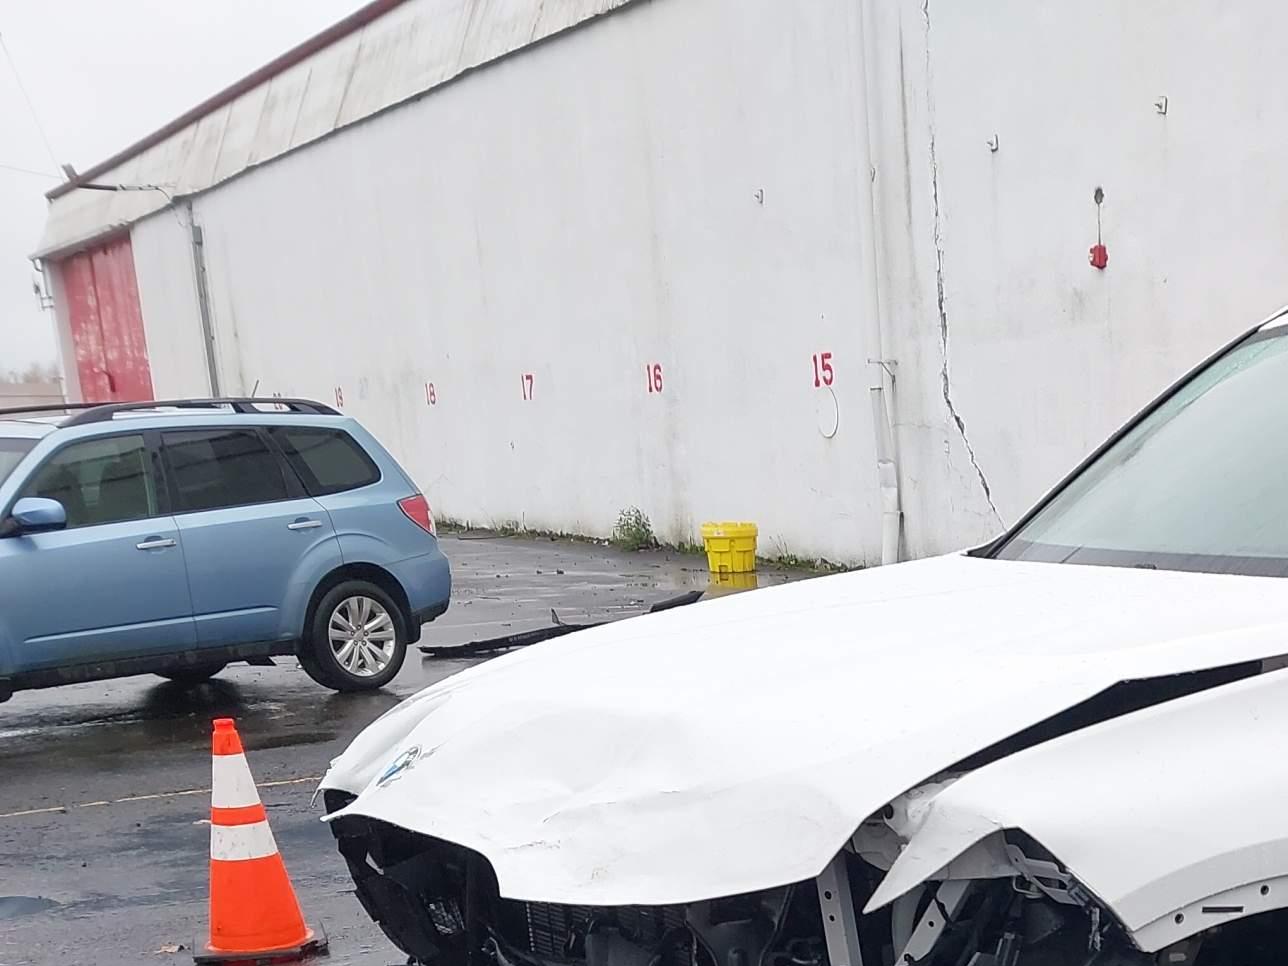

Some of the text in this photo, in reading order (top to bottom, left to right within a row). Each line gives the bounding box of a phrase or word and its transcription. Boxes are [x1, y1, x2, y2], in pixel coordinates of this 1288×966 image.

[646, 363, 663, 393] 16
[812, 352, 834, 388] 15
[424, 382, 437, 406] 18
[521, 373, 534, 401] 17
